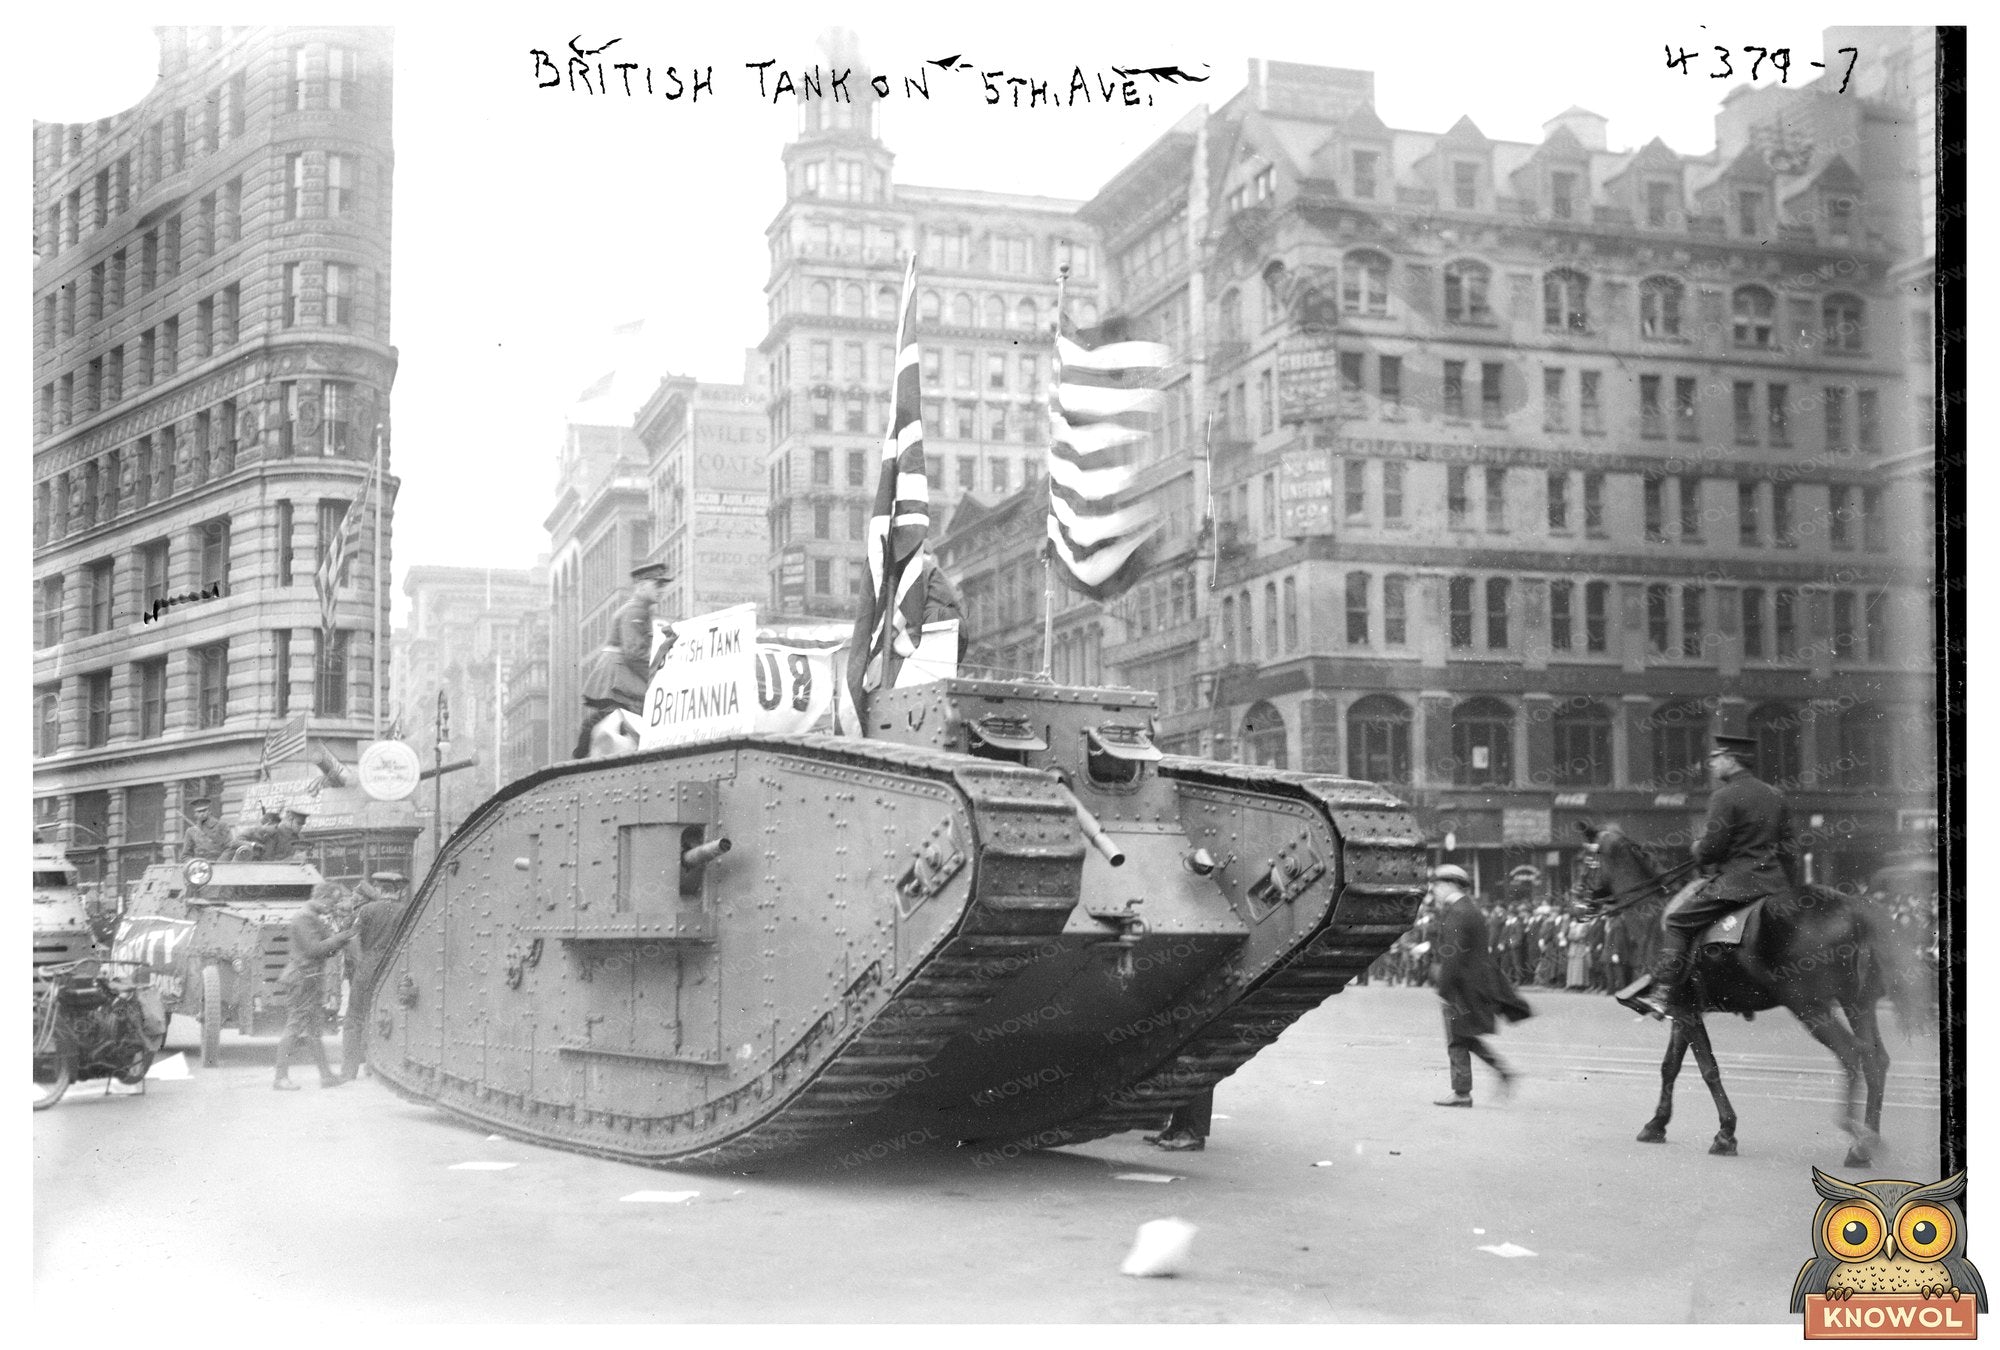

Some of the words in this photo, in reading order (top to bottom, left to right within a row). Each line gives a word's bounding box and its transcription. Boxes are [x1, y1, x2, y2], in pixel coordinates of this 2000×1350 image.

[529, 49, 714, 102] BRITISH
[746, 58, 853, 104] TANK
[872, 65, 931, 101] ON
[708, 626, 742, 659] TANK
[650, 681, 740, 728] BRITANNIA
